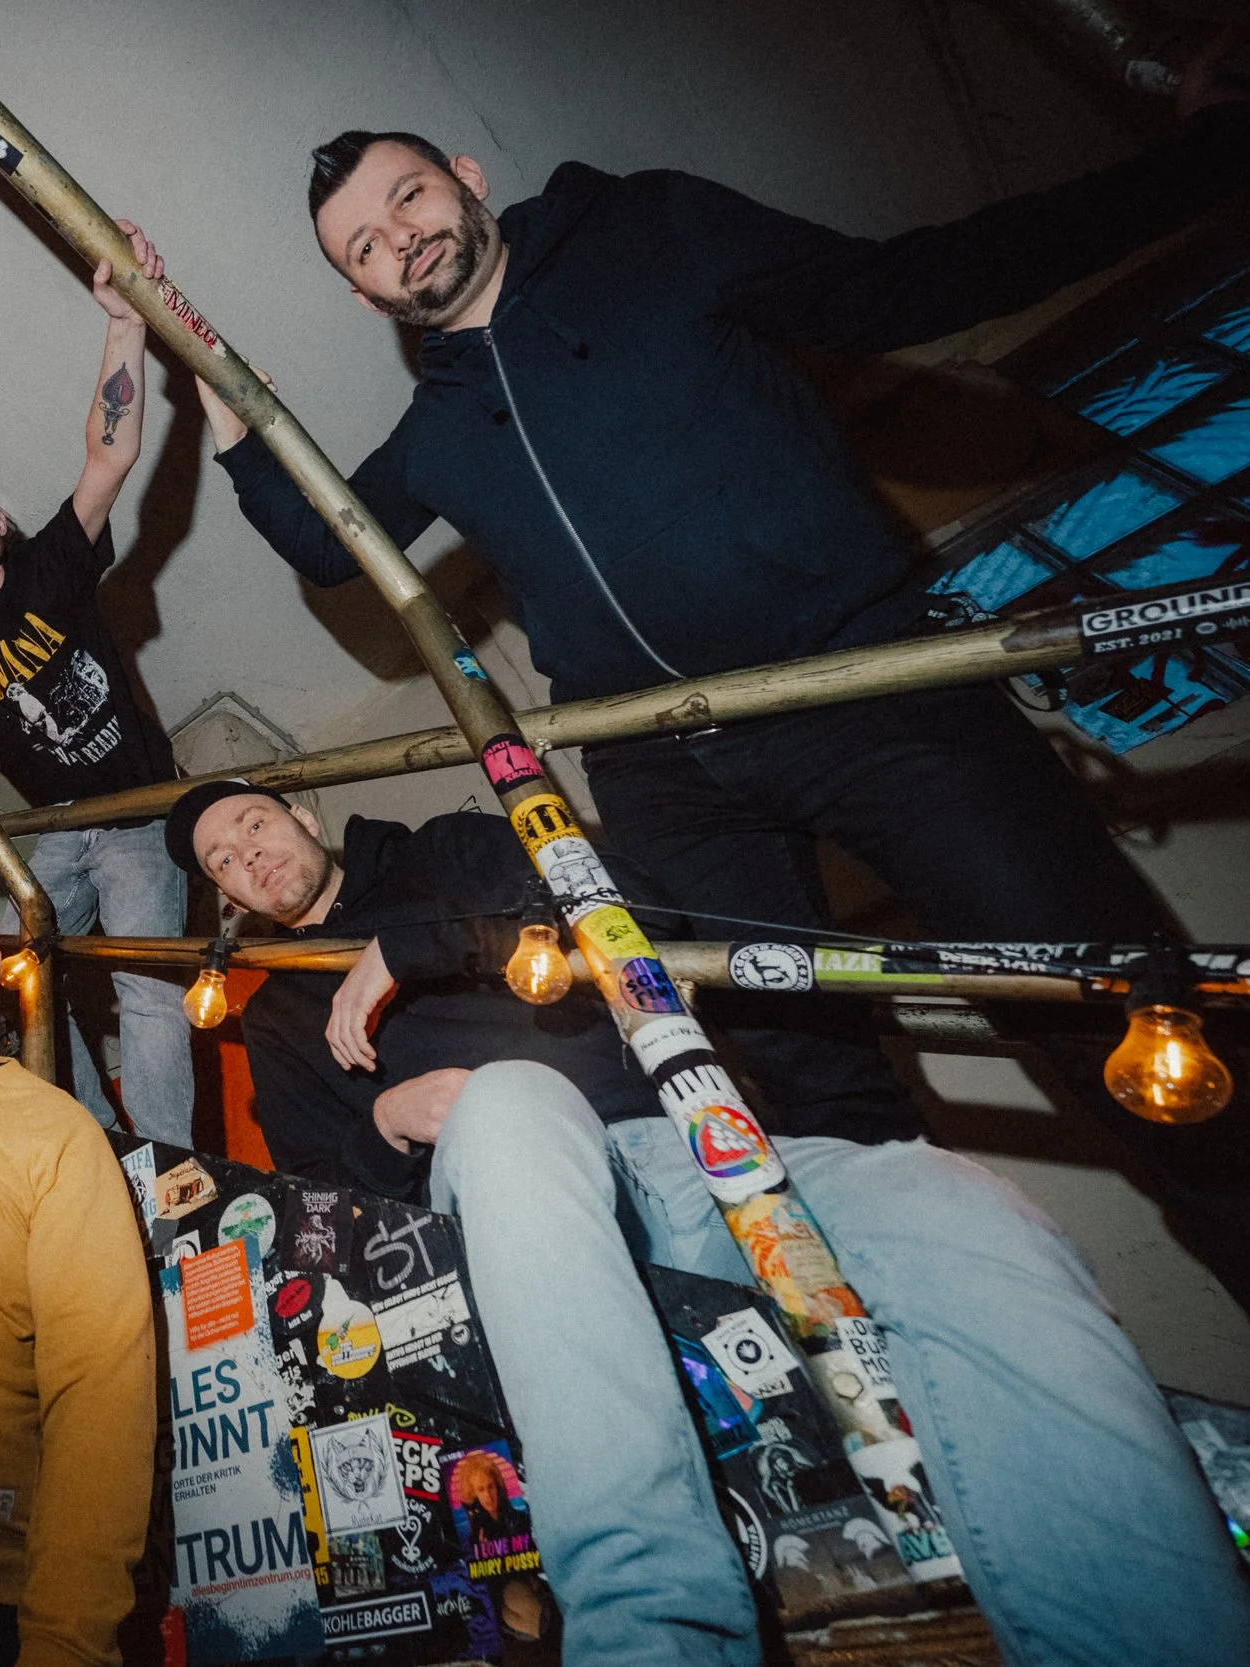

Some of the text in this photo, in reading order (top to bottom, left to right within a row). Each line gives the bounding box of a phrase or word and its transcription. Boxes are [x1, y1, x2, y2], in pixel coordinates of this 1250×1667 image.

[1094, 637, 1133, 653] EST.
[306, 1203, 333, 1214] DARK
[172, 1400, 274, 1471] INNT
[173, 1465, 242, 1491] ORTE DER KRITIK
[174, 1483, 217, 1502] ERHALTEN
[400, 1462, 441, 1494] PS
[172, 1511, 310, 1588] TRUM
[474, 1533, 530, 1560] I LOVE MY
[469, 1551, 541, 1580] HAIRY PUSSY
[190, 1567, 312, 1598] allesbeginntimzentrum.org
[321, 1602, 422, 1634] KOHLEBAGGER
